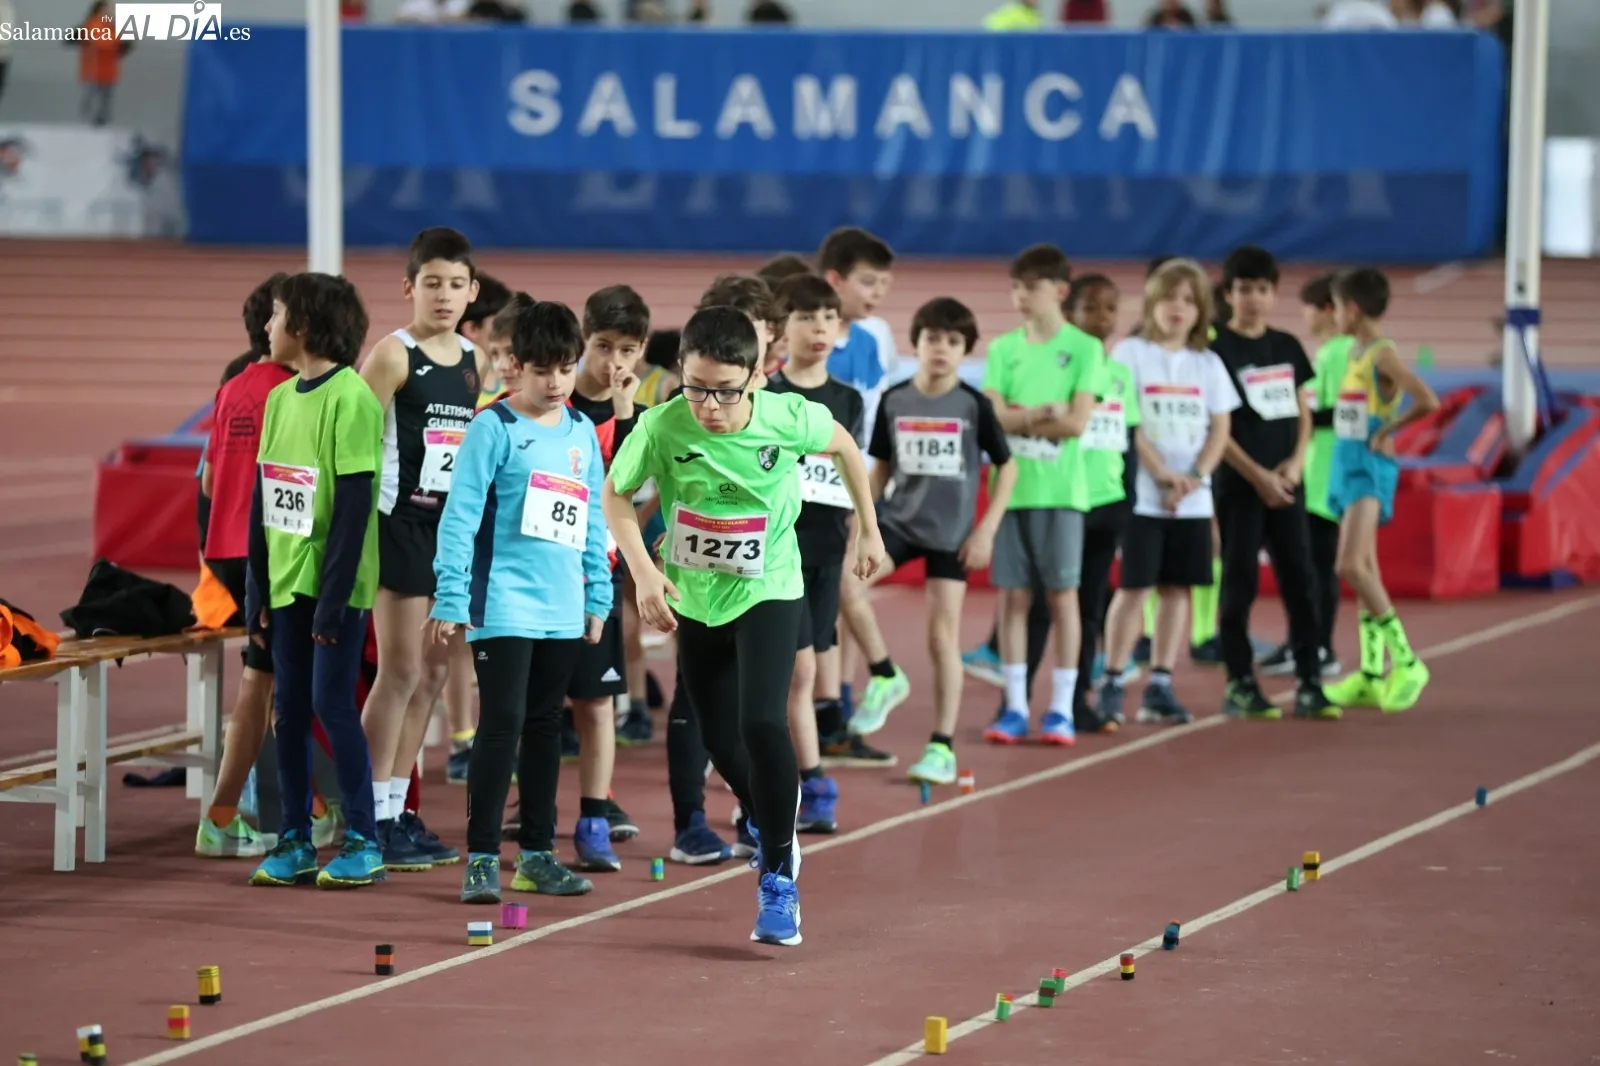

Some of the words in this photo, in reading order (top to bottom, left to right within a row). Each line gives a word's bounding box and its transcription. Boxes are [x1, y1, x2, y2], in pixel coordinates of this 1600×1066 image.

[508, 69, 1158, 140] SALAMANCA
[274, 487, 305, 513] 236
[551, 500, 578, 527] 85
[685, 533, 761, 560] 1273
